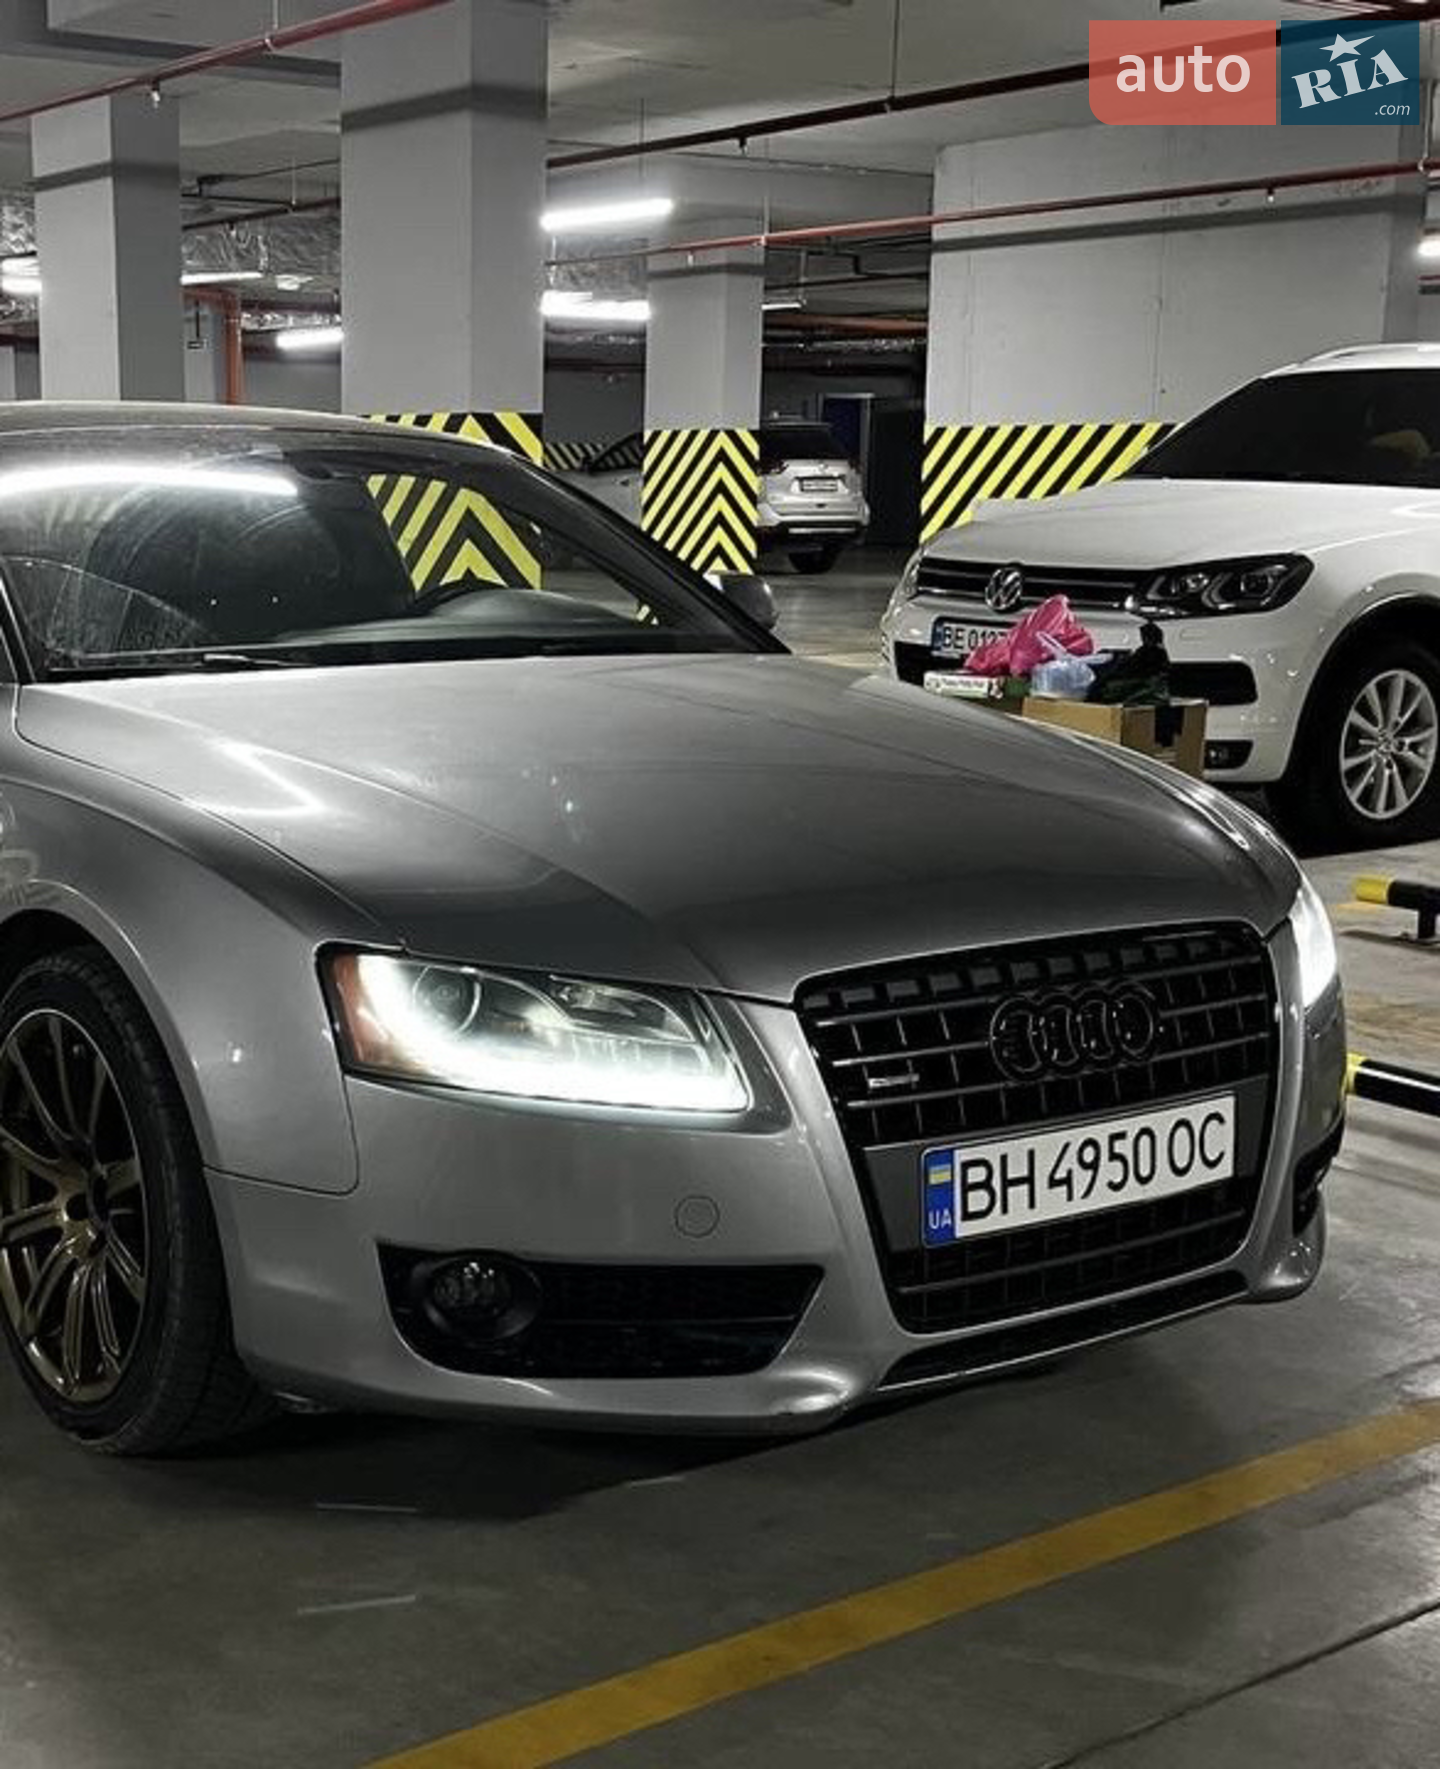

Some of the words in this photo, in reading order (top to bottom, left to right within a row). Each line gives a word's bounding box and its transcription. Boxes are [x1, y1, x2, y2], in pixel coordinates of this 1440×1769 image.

[943, 626, 966, 649] BE
[960, 1148, 1036, 1222] BH
[1047, 1126, 1157, 1203] 4950
[1167, 1111, 1226, 1177] OC
[928, 1210, 952, 1230] UA
